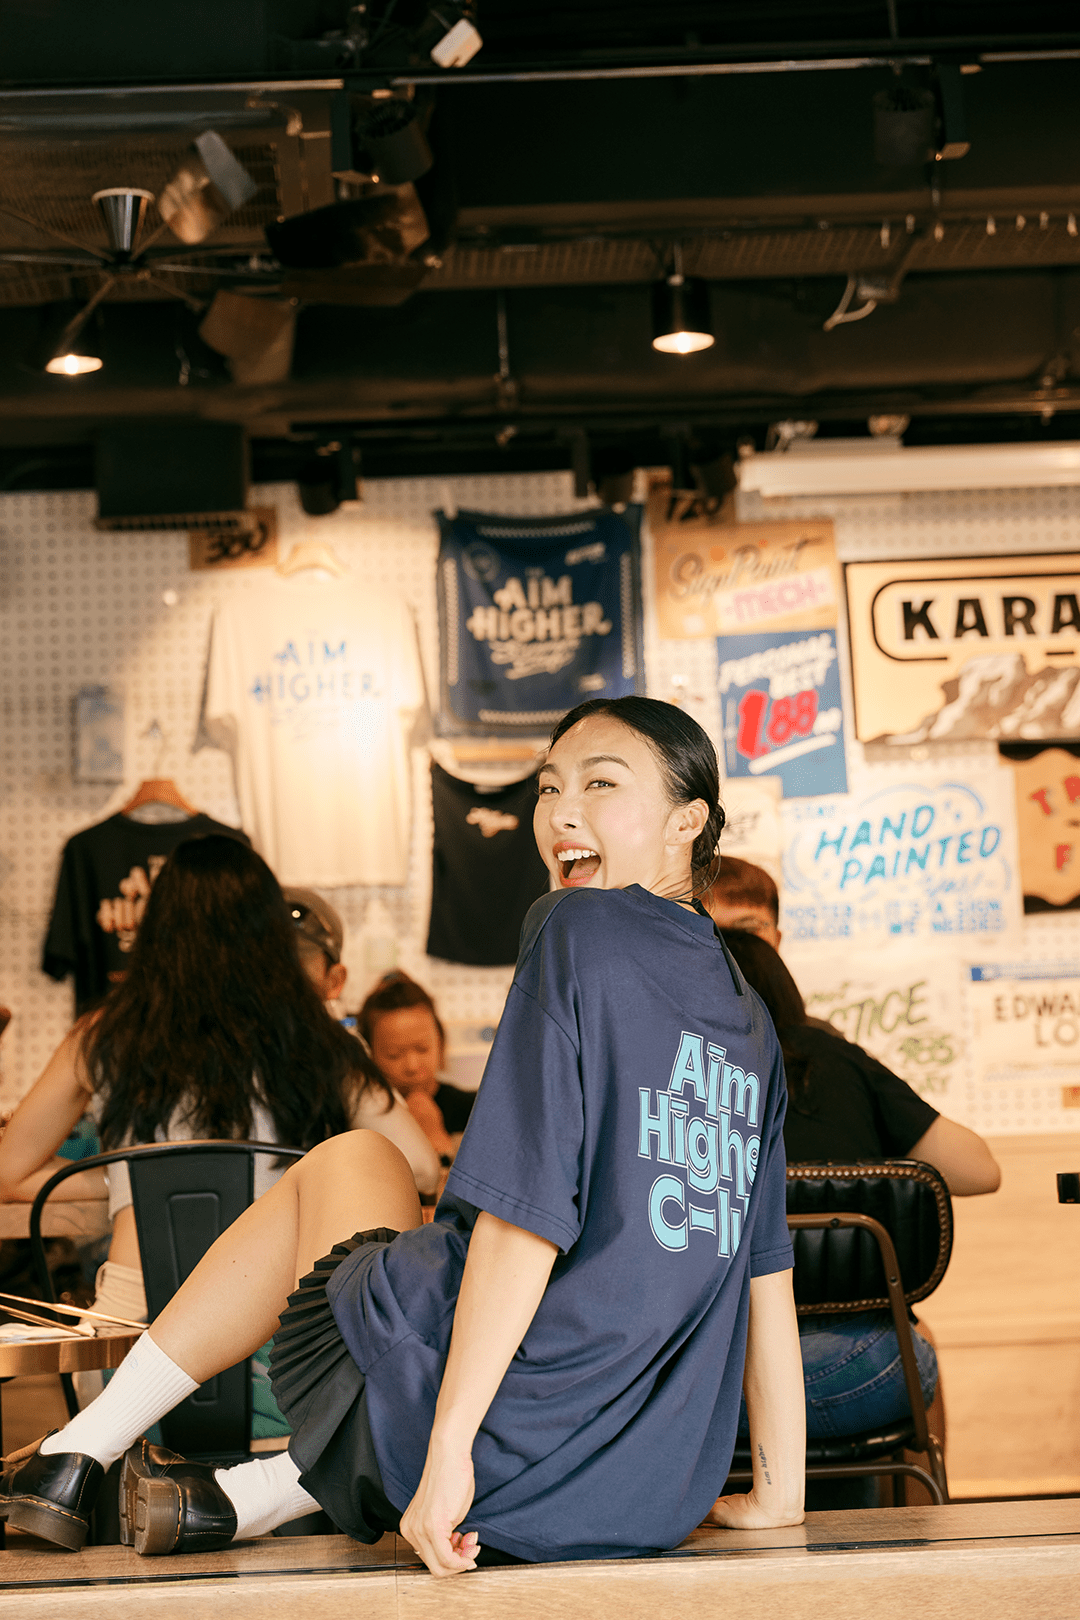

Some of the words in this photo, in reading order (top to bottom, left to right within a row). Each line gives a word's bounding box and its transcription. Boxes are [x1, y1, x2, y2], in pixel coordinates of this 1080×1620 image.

[493, 567, 574, 612] AIM
[273, 629, 348, 666] AIM
[814, 804, 935, 862] HAND
[839, 826, 1001, 889] PAINTED
[668, 1031, 760, 1127] Aim
